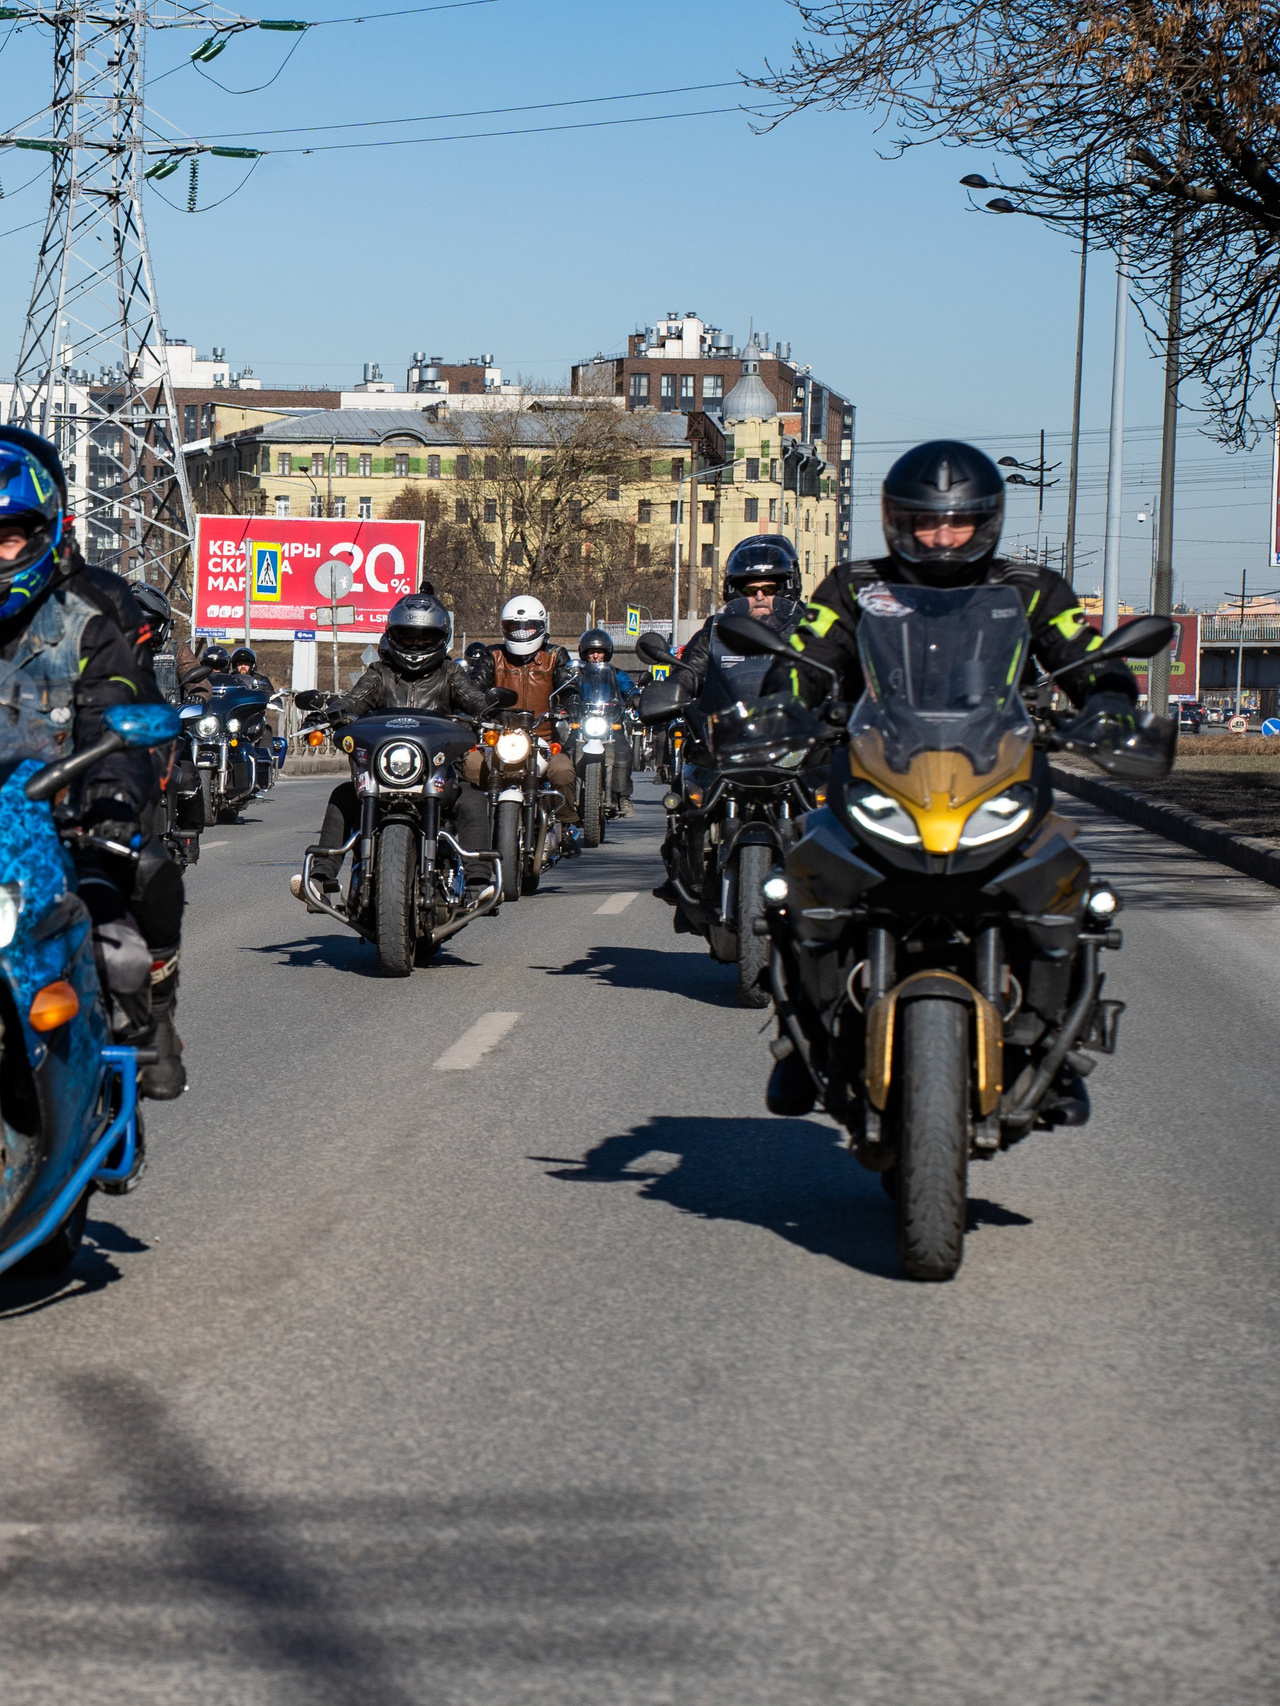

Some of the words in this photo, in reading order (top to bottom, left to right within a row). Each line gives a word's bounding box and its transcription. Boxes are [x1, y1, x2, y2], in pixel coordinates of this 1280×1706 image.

[209, 540, 321, 558] КВАИРЫ
[208, 557, 293, 574] СКИА
[207, 576, 252, 592] МАР
[369, 614, 388, 623] LSR
